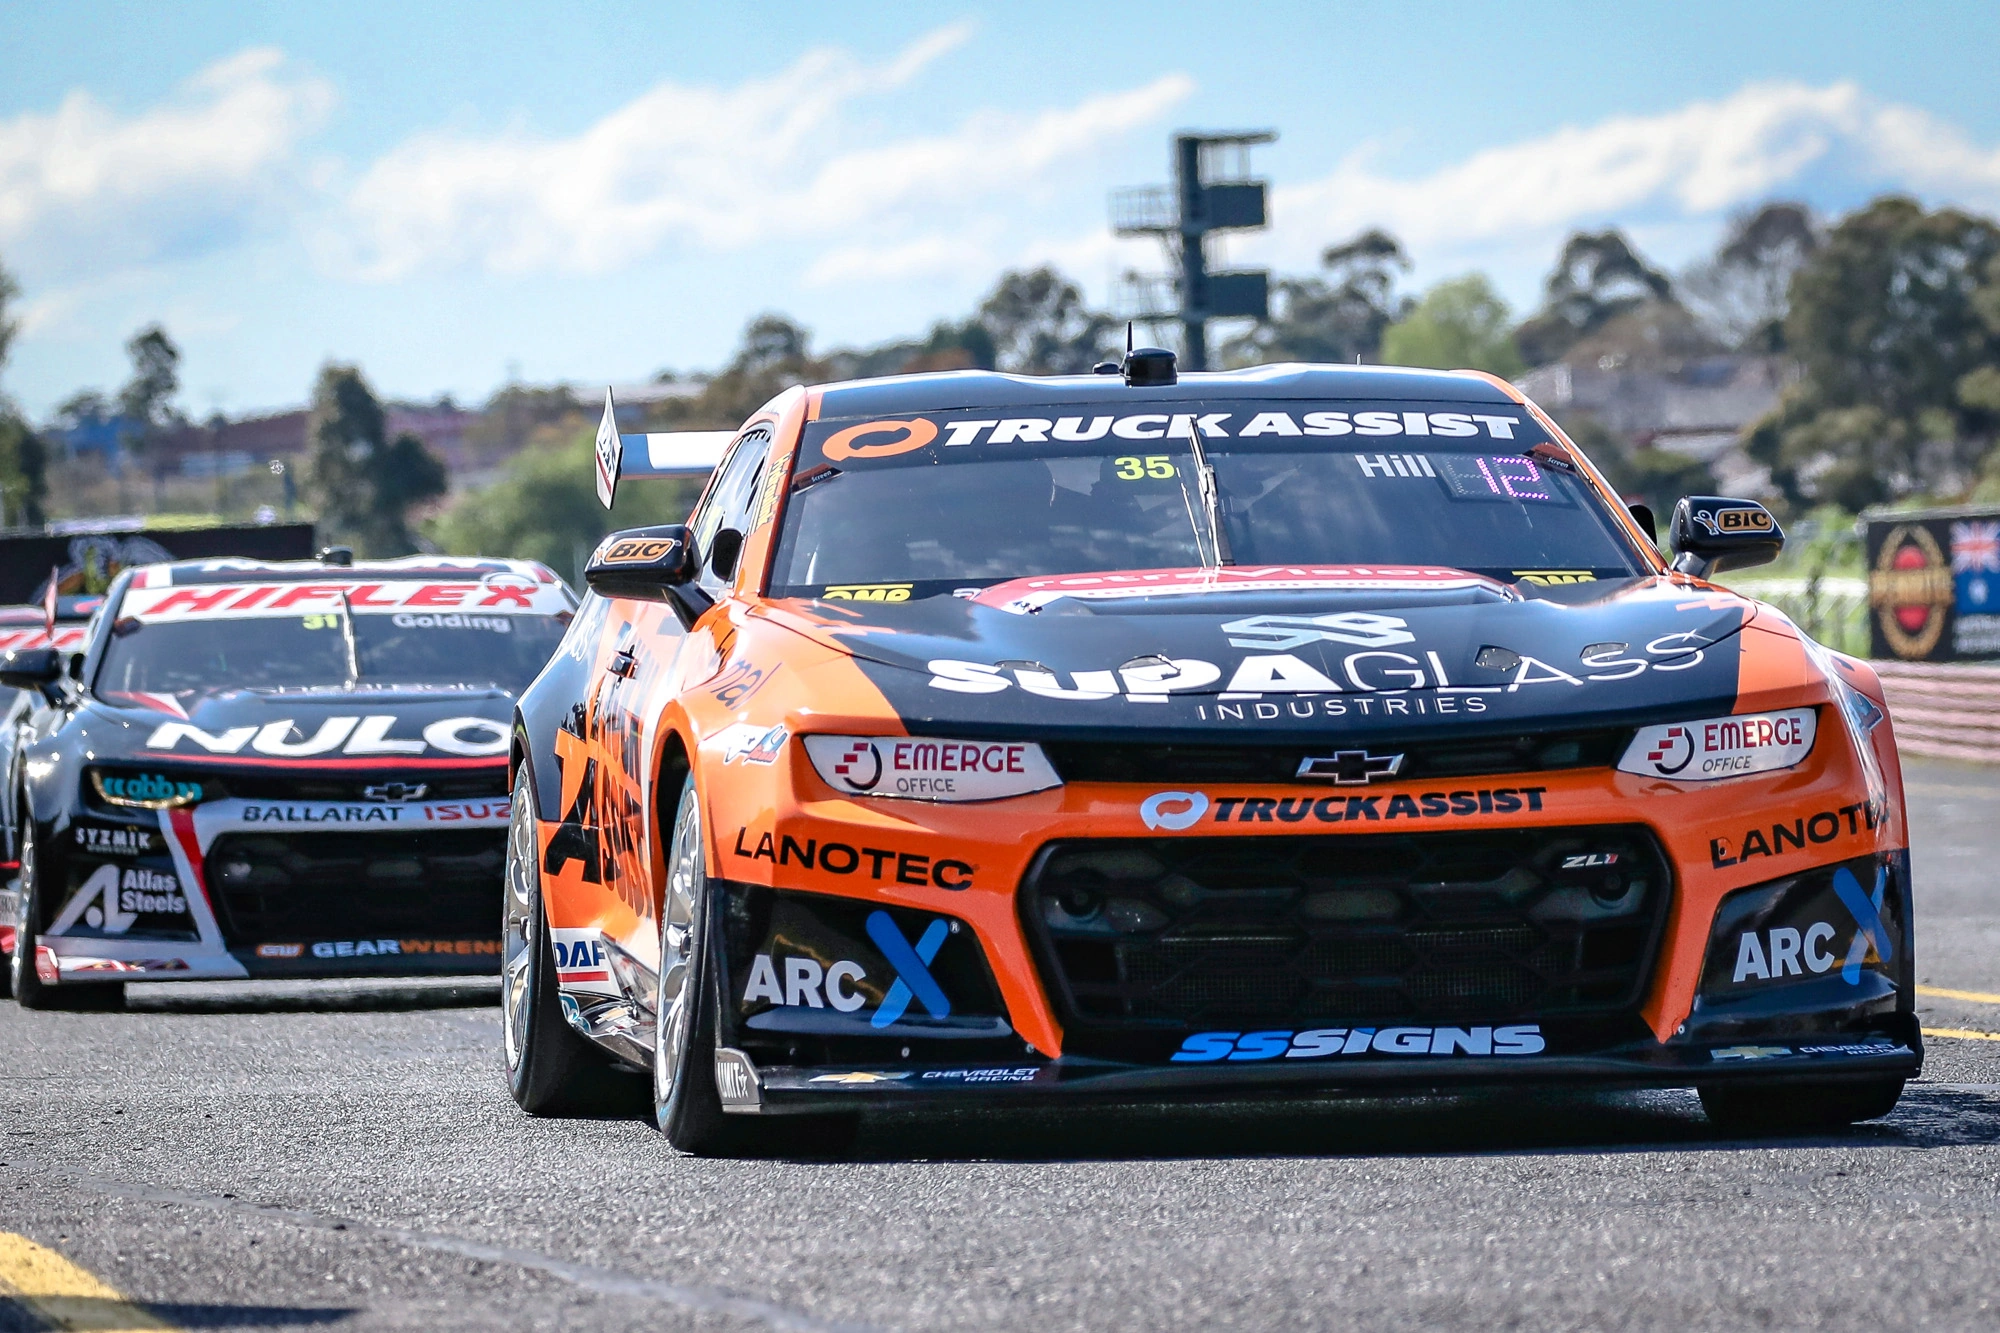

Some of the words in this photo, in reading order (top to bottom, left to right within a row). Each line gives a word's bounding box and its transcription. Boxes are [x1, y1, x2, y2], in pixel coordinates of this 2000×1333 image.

[944, 413, 1232, 447] TRUCK
[1238, 411, 1520, 440] ASSIST
[1114, 456, 1175, 480] 35
[1354, 454, 1436, 478] Hill
[1476, 457, 1549, 499] 12
[142, 584, 539, 615] HIFLEX
[303, 614, 338, 630] 31
[392, 613, 512, 633] Golding
[1198, 696, 1488, 720] INDUSTRIES
[1704, 717, 1802, 752] EMERGE
[893, 743, 1025, 773] EMERGE
[1702, 755, 1751, 772] OFFICE
[896, 777, 956, 793] OFFICE
[242, 806, 404, 822] BALLARAT
[734, 827, 976, 891] LANOTEC
[1562, 853, 1618, 868] ZL1
[122, 869, 176, 892] Atlas
[121, 890, 186, 914] Steels
[922, 1067, 1040, 1079] CHEVROLET
